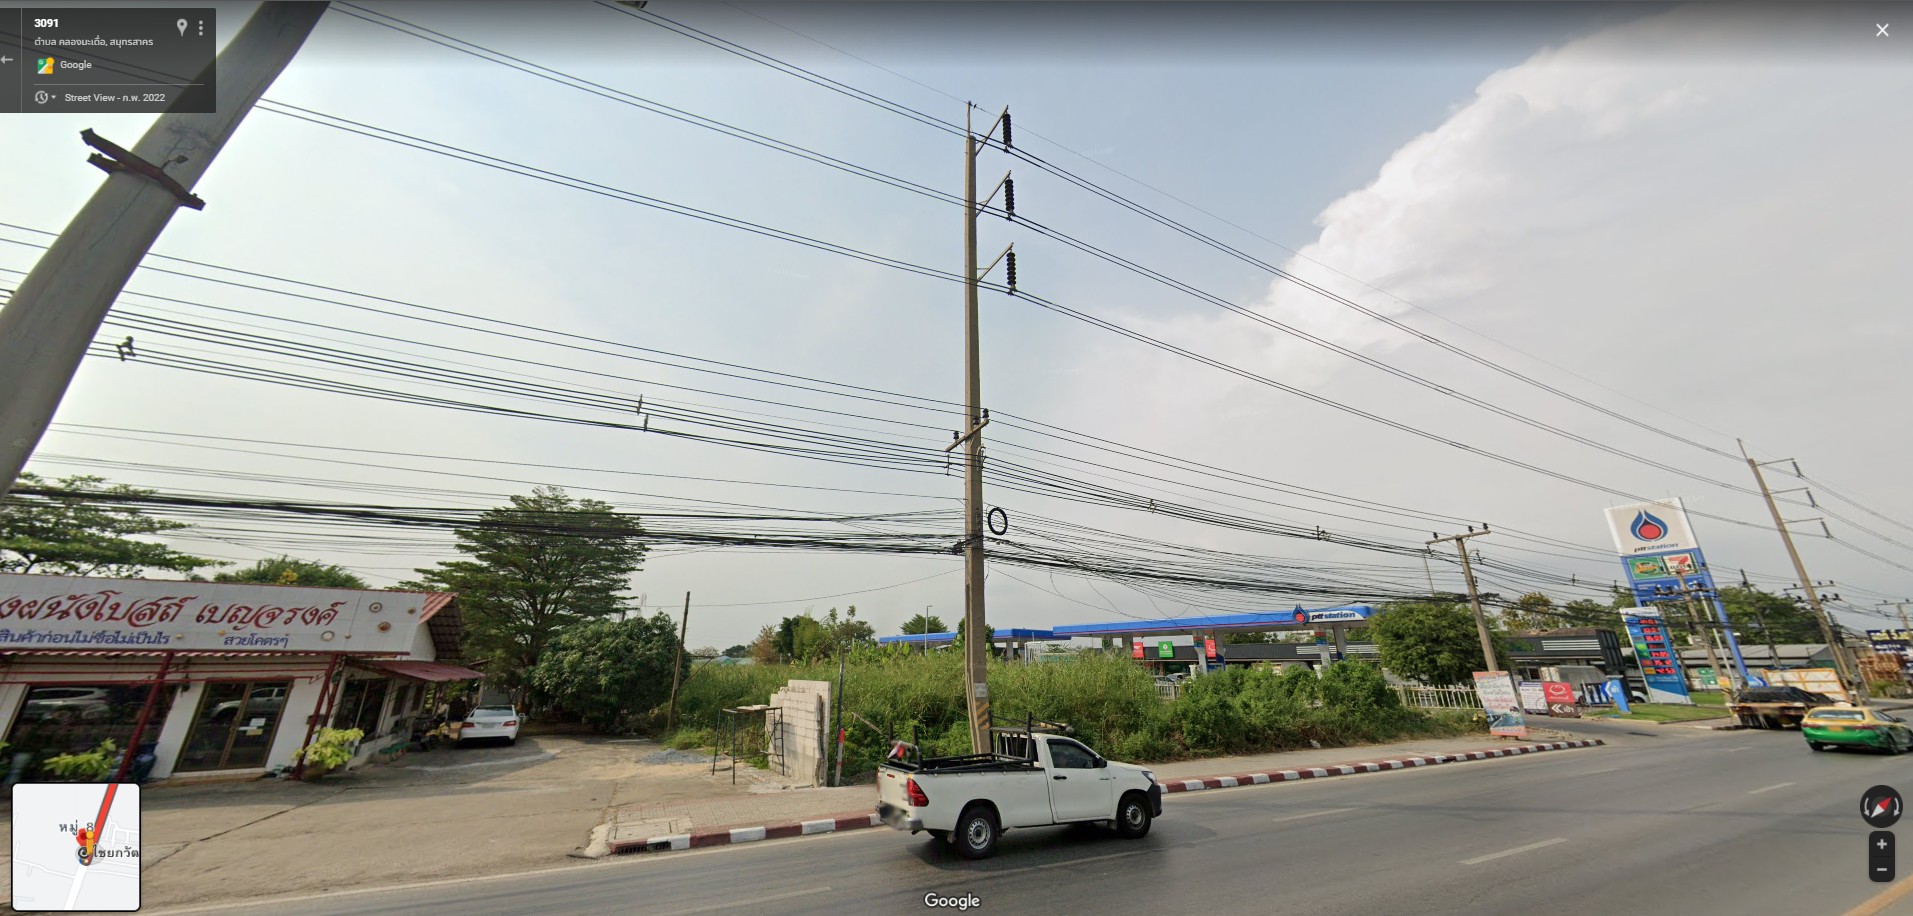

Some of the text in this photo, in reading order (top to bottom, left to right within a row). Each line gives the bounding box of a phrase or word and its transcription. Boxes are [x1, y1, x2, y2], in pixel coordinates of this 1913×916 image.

[196, 601, 348, 630] เบญจรงค์
[224, 633, 289, 648] สวยโคตรๆ
